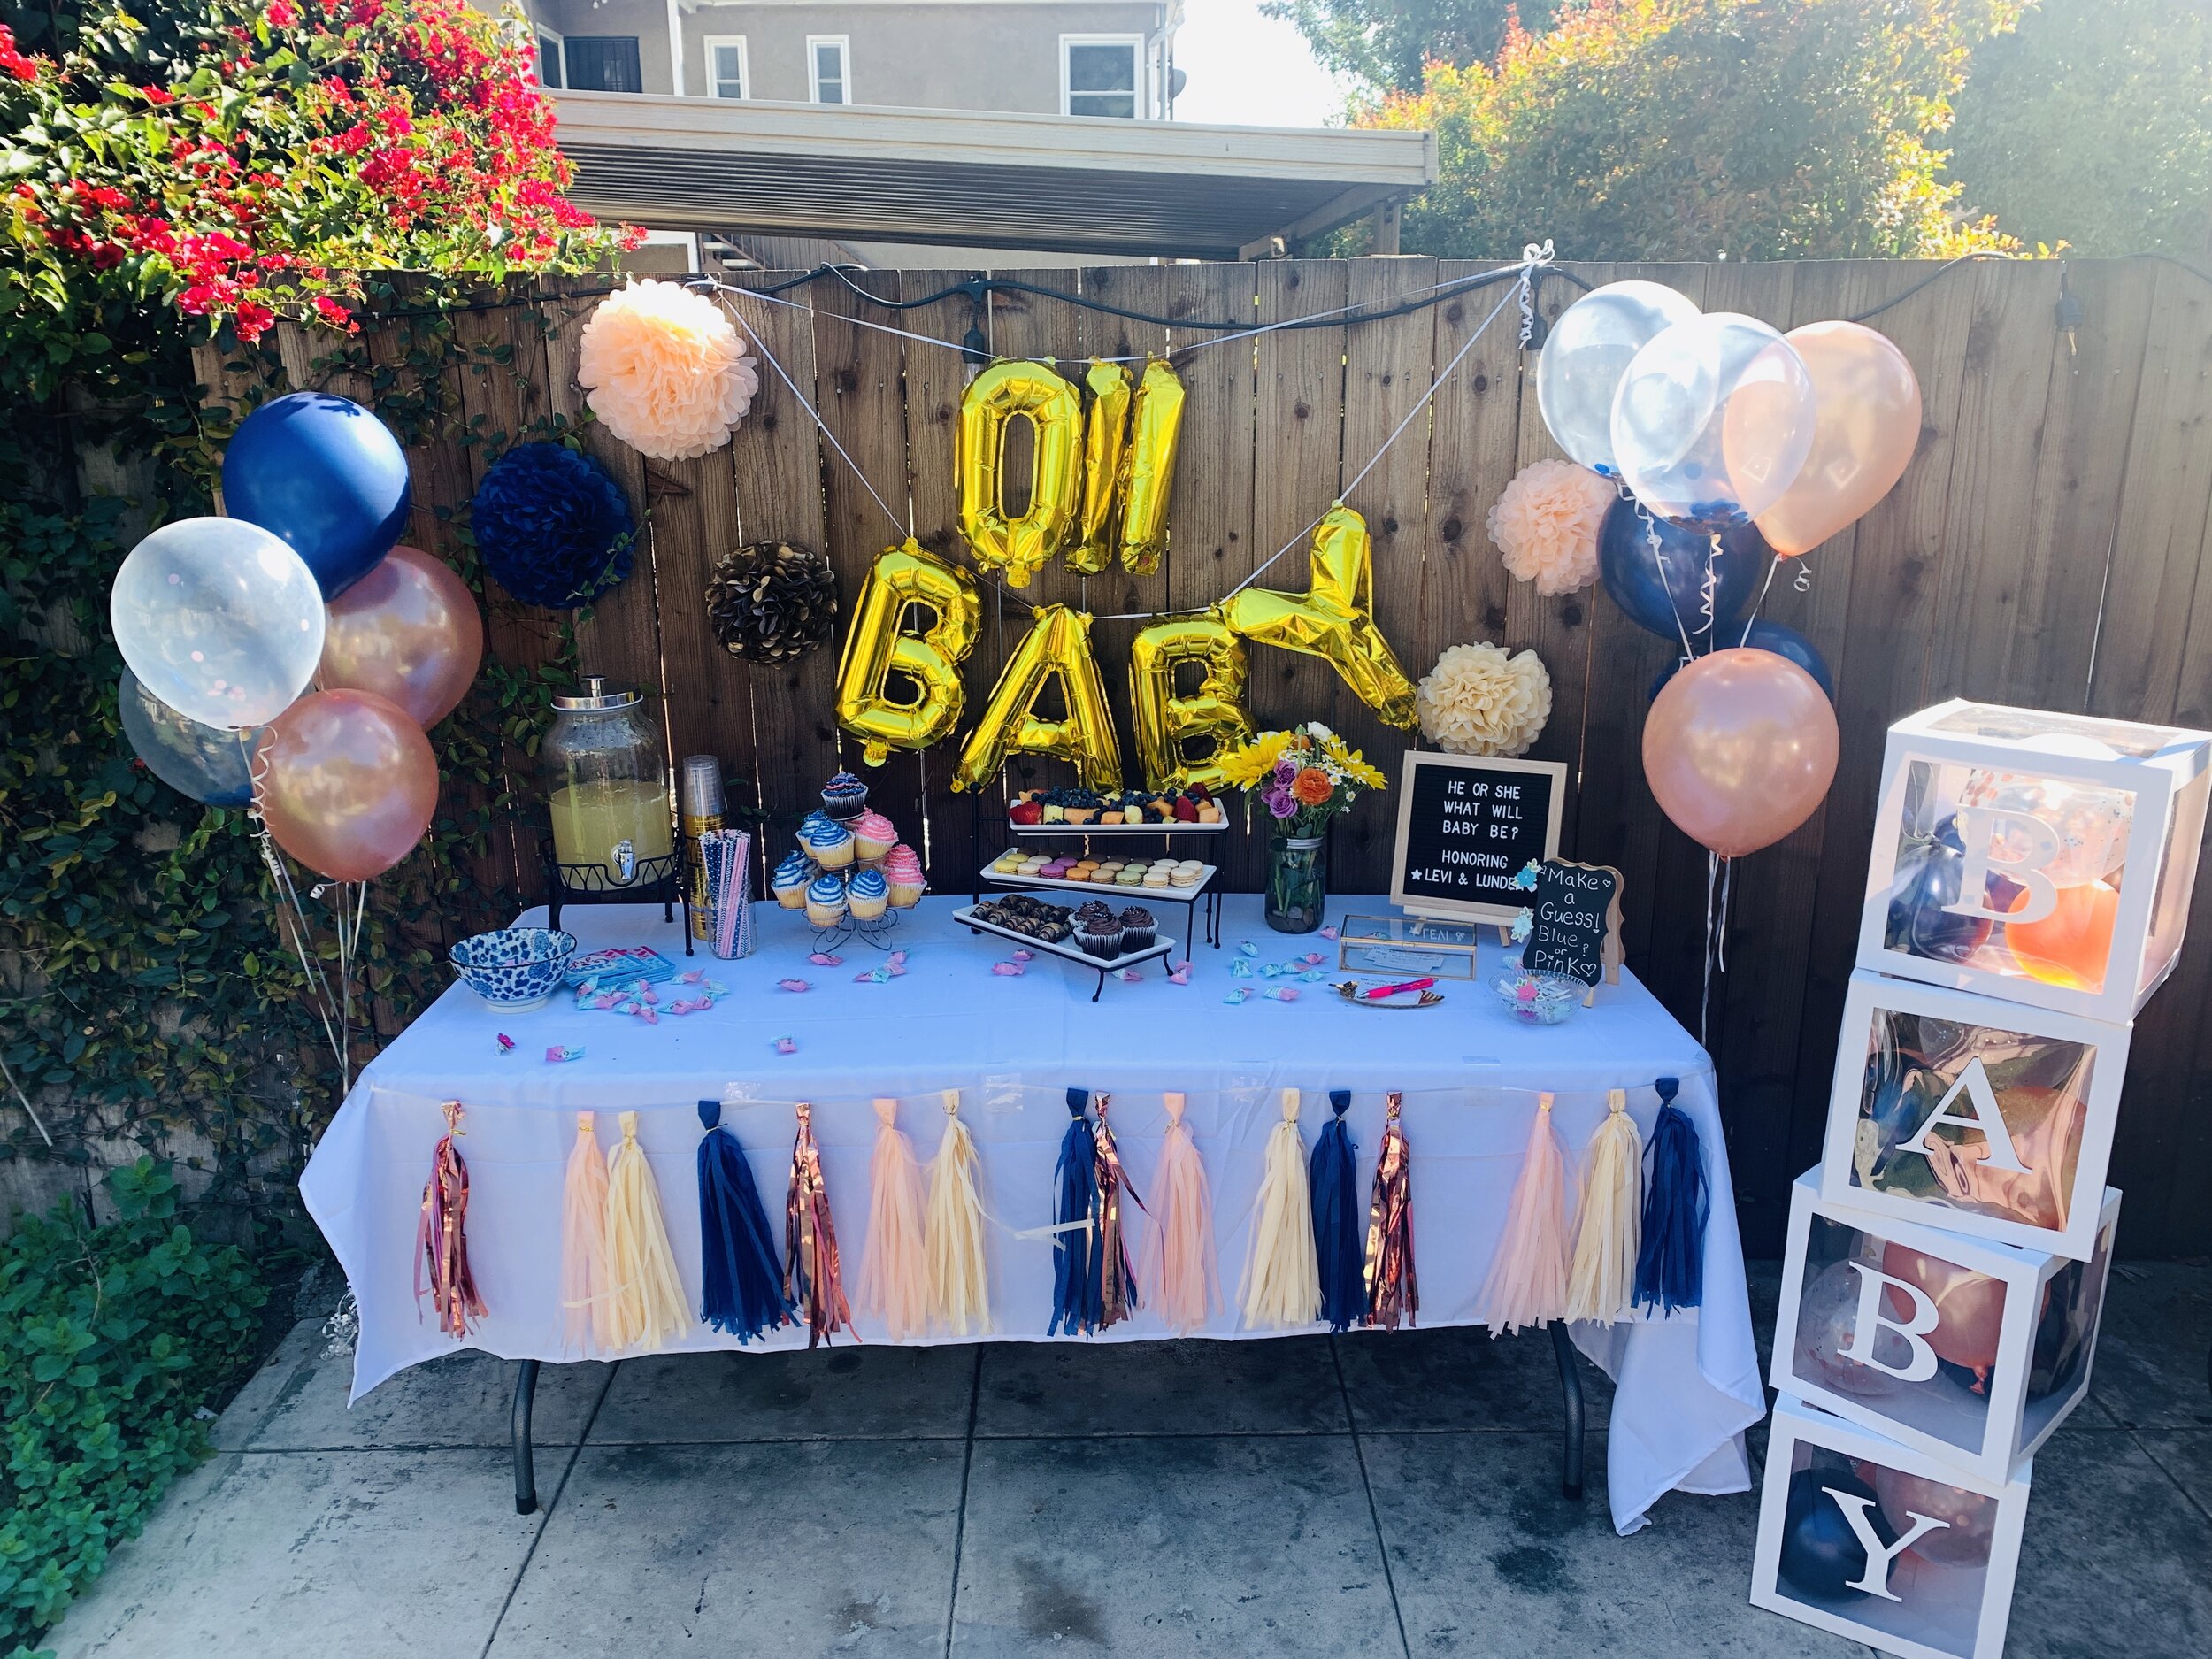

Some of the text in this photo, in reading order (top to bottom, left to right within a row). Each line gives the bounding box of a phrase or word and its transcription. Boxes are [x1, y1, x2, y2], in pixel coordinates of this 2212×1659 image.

[836, 502, 1420, 794] BABY
[1448, 780, 1521, 800] HE OR SHE
[1443, 800, 1523, 819] WHAT WILL
[1442, 820, 1519, 840] BABY BE?
[1441, 849, 1509, 869] HONORING
[1425, 868, 1524, 891] LEVI & LUNDE
[1564, 893, 1575, 904] a
[1540, 902, 1600, 934] Guess!
[1538, 925, 1578, 948] Blue
